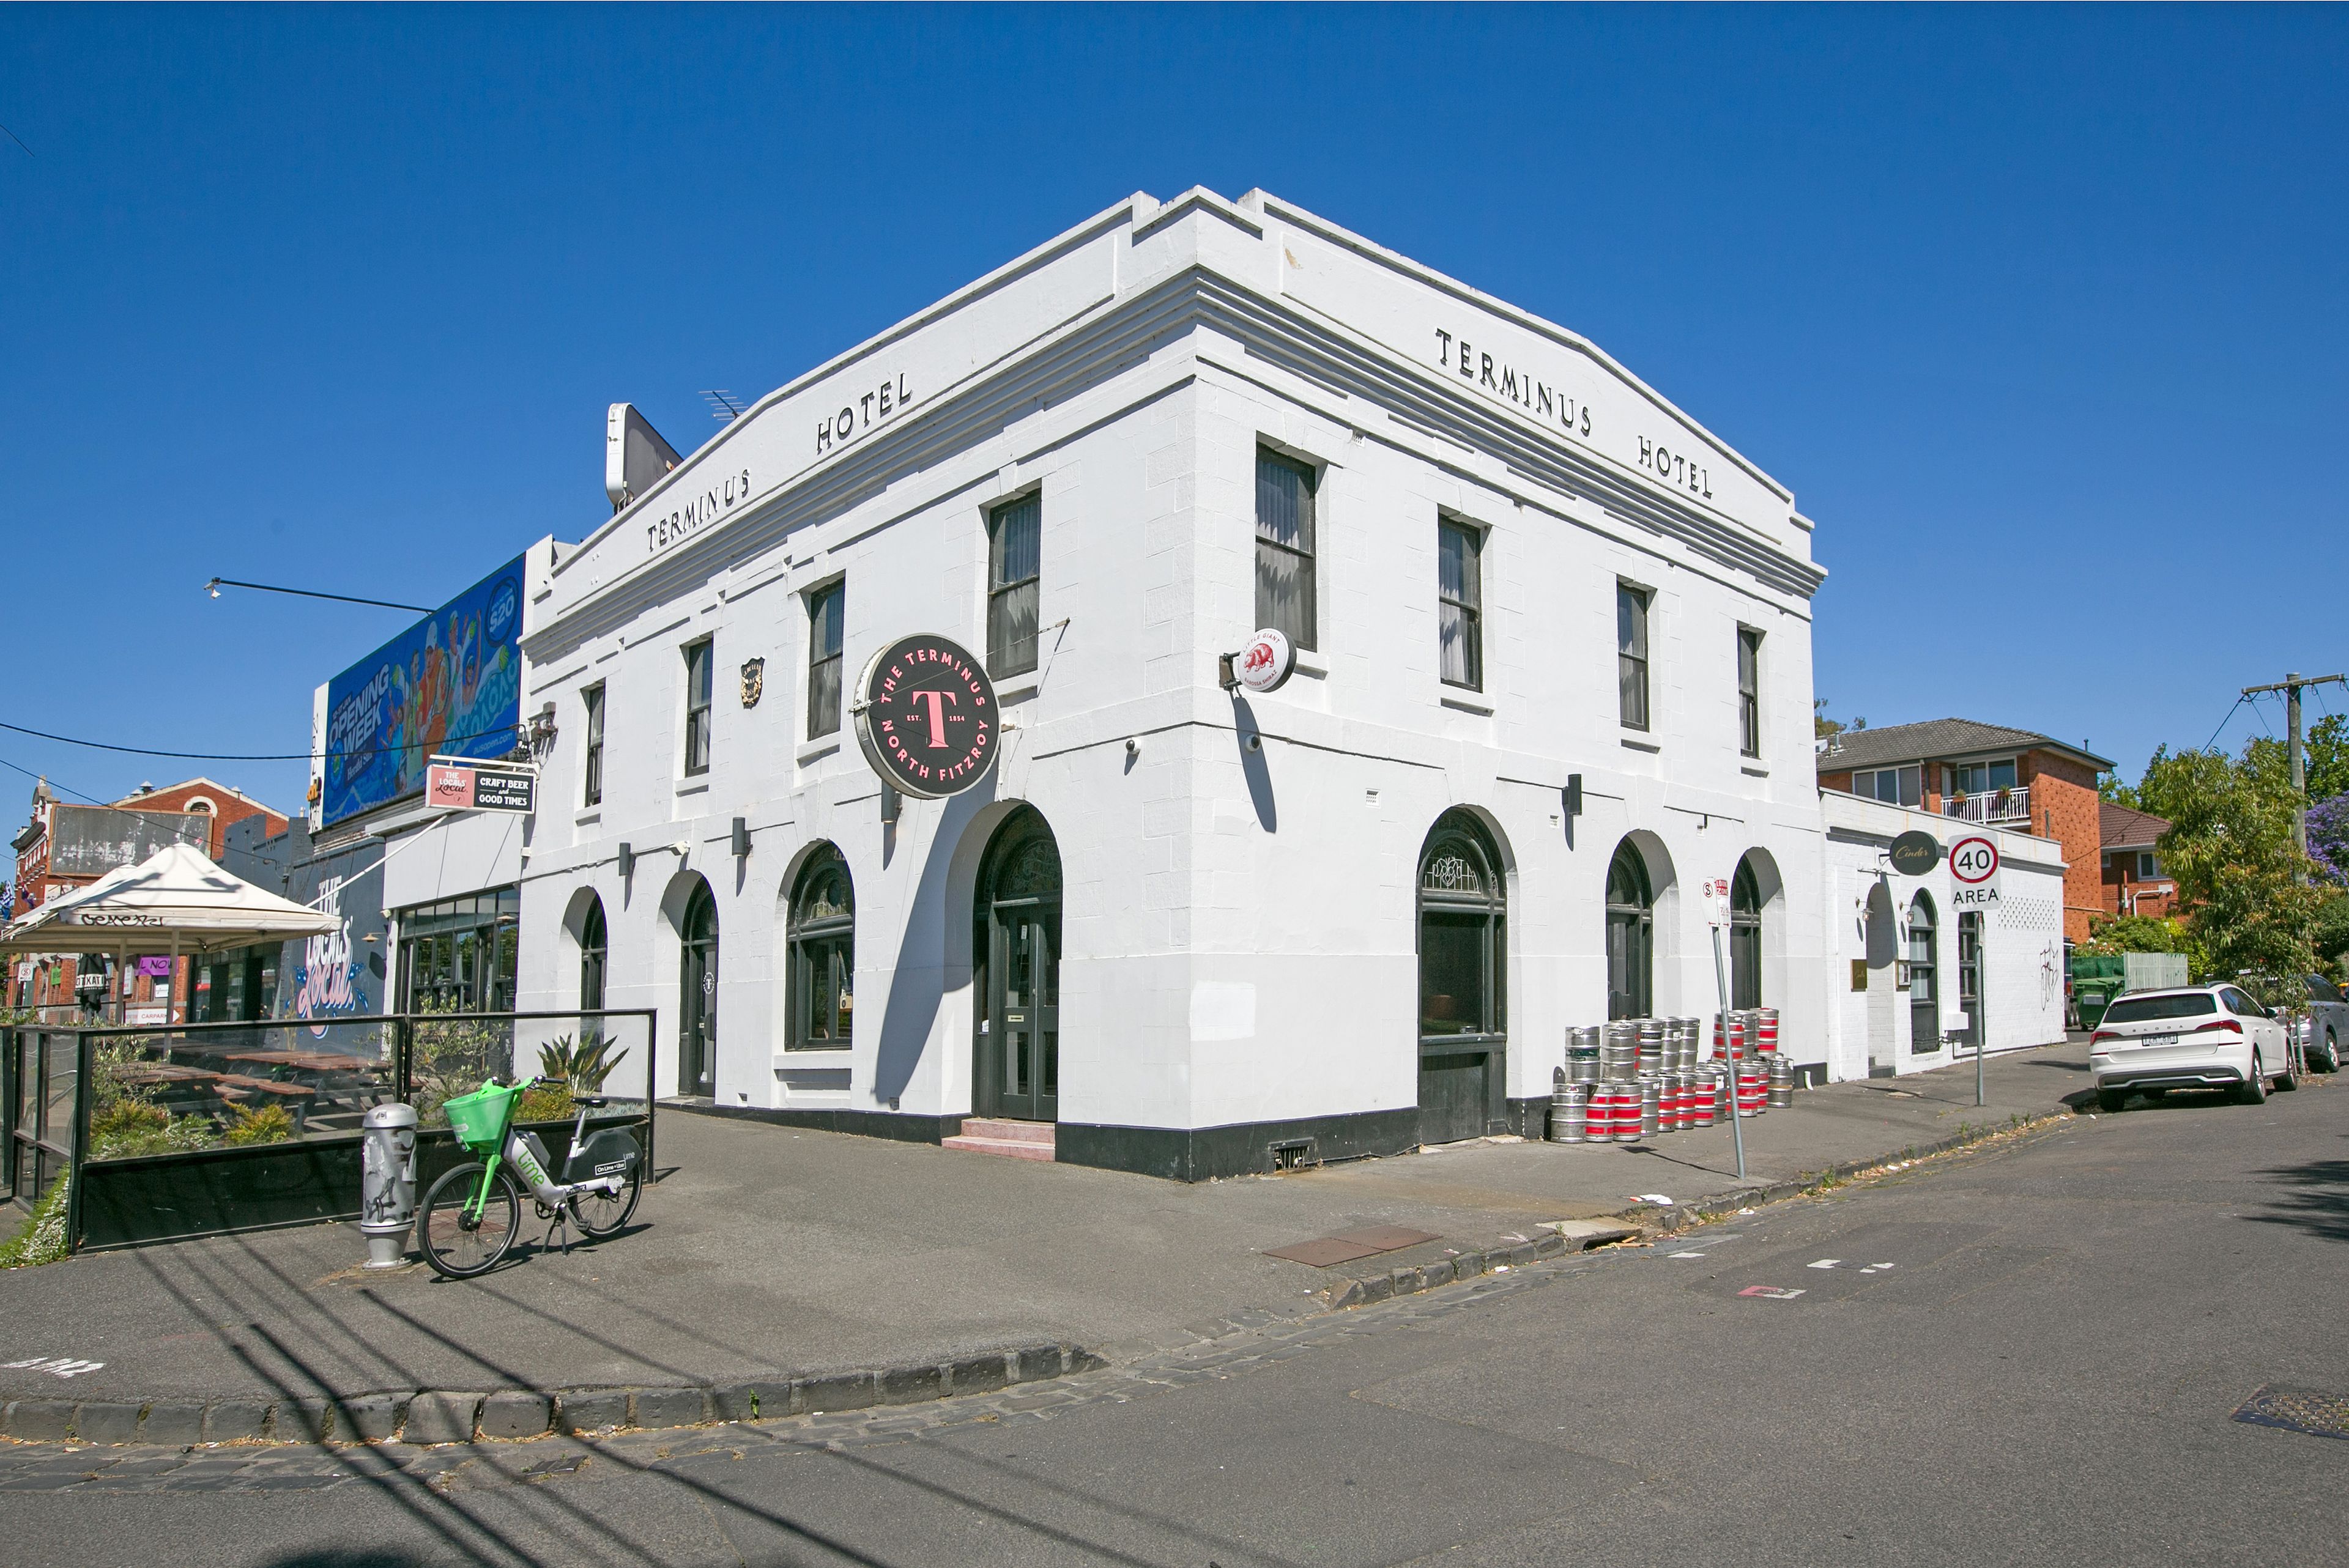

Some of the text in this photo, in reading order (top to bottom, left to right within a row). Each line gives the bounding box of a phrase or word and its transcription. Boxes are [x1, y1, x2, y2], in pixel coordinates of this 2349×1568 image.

[1435, 327, 1713, 499] TERMINUS HOTEL
[647, 372, 913, 552] TERMINUS HOTEL
[1263, 633, 1280, 643] GIANT
[881, 649, 985, 706] THE TERMINUS
[1262, 670, 1277, 684] SHIRAZ
[329, 663, 390, 750] OPENING
[912, 691, 957, 748] T
[343, 698, 382, 761] WEEK
[473, 732, 513, 755] ausopen.com
[881, 720, 989, 781] NORTH FITZROY
[479, 794, 527, 806] GOOD TIMES
[480, 777, 529, 790] CRAFT BEER
[1896, 846, 1929, 859] Cinder
[1958, 849, 1990, 870] 40
[319, 875, 342, 916] THE
[1953, 888, 1999, 904] AREA
[518, 1150, 545, 1187] Lime
